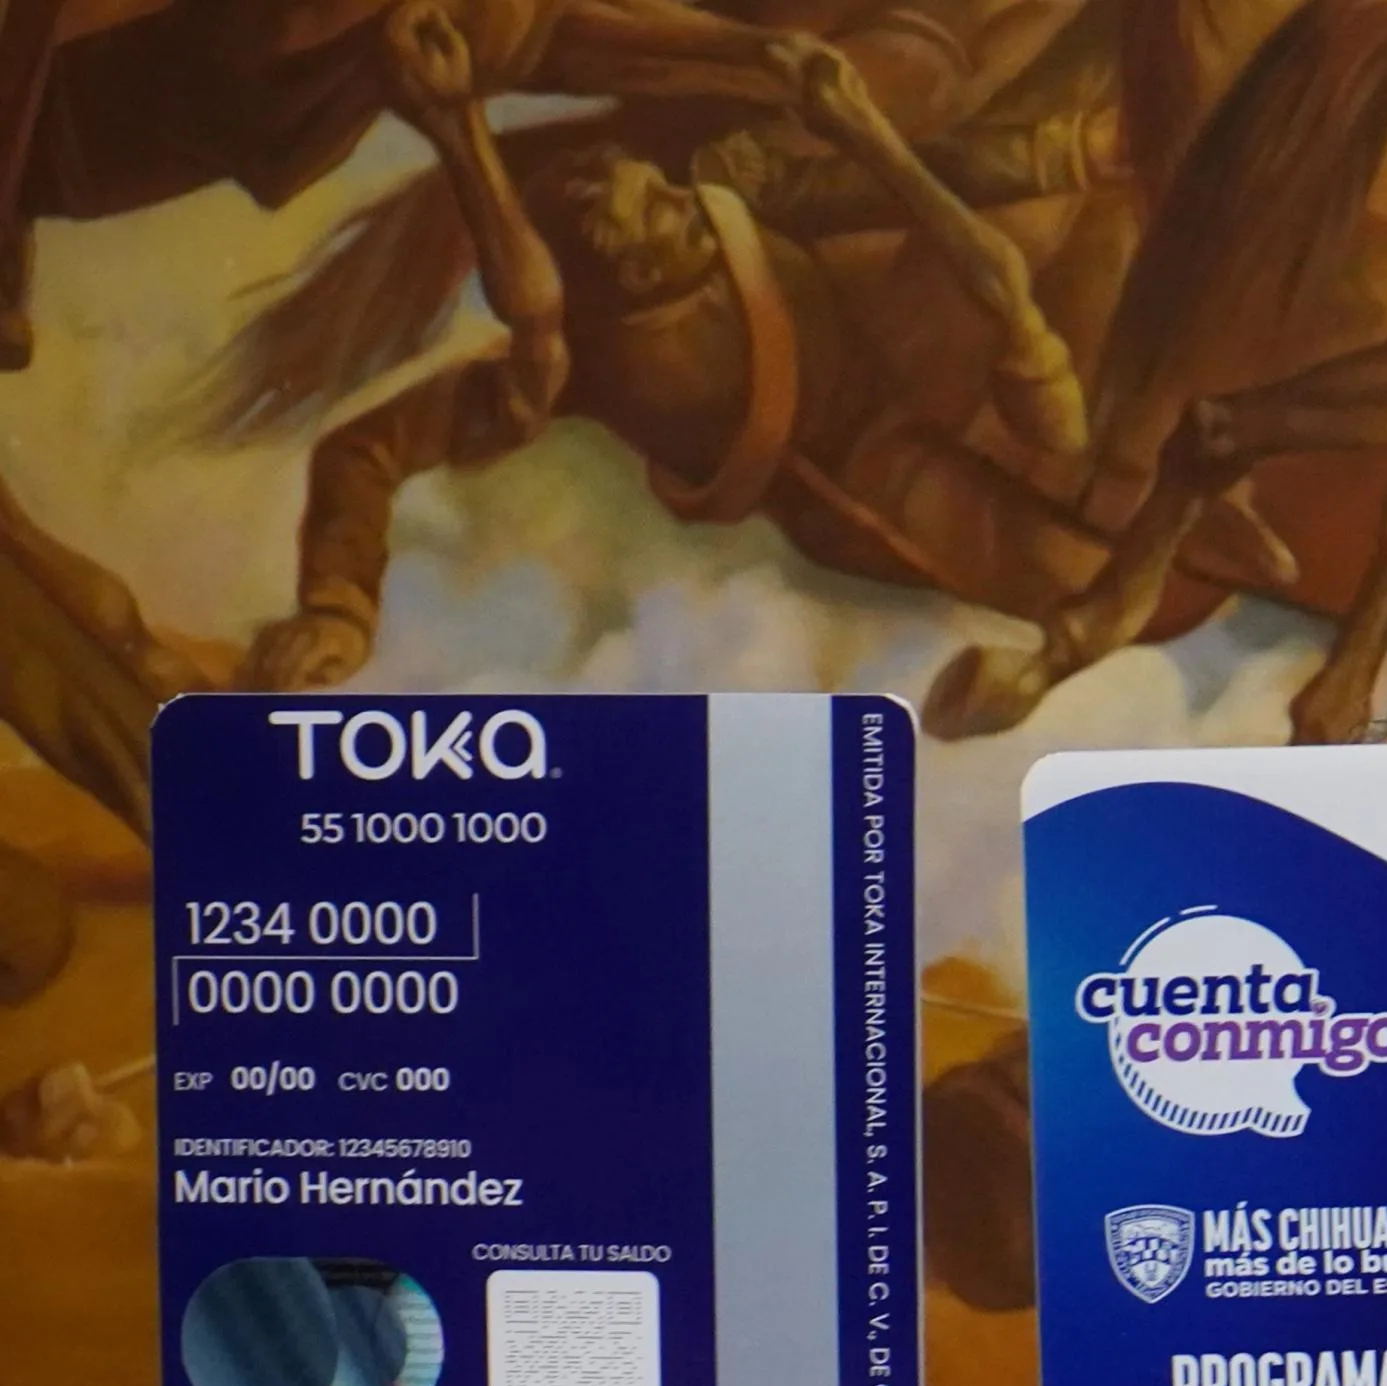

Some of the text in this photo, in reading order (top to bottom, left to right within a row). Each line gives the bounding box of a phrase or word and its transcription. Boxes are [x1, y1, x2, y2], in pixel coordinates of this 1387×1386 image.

[269, 709, 548, 780] TOKA
[862, 712, 884, 808] EMITIDA
[300, 811, 547, 844] 55 1000 1000
[863, 814, 884, 864] POR
[864, 872, 885, 936] TOKA
[187, 901, 437, 945] 1234 0000
[188, 970, 459, 1014] 0000 0000
[1081, 962, 1314, 1019] cuenta
[863, 942, 887, 1137] INTERNACIONAL,
[174, 1061, 450, 1096] EXP 00/00 CVC 000
[174, 1138, 472, 1158] IDENTIFICADOR: 12345678910
[866, 1143, 888, 1165] S.
[174, 1168, 523, 1206] Mario Hernández
[866, 1170, 888, 1194] A.
[867, 1200, 888, 1220] P.
[1203, 1201, 1271, 1252] MÁS
[472, 1243, 672, 1264] CONSULTA TU SALDO
[868, 1246, 889, 1275] DE
[1205, 1252, 1269, 1277] más
[1277, 1252, 1315, 1274] de
[1324, 1251, 1351, 1273] lo
[1206, 1280, 1319, 1298] GOBIERNO
[1326, 1279, 1368, 1296] DEL
[869, 1347, 891, 1378] DE
